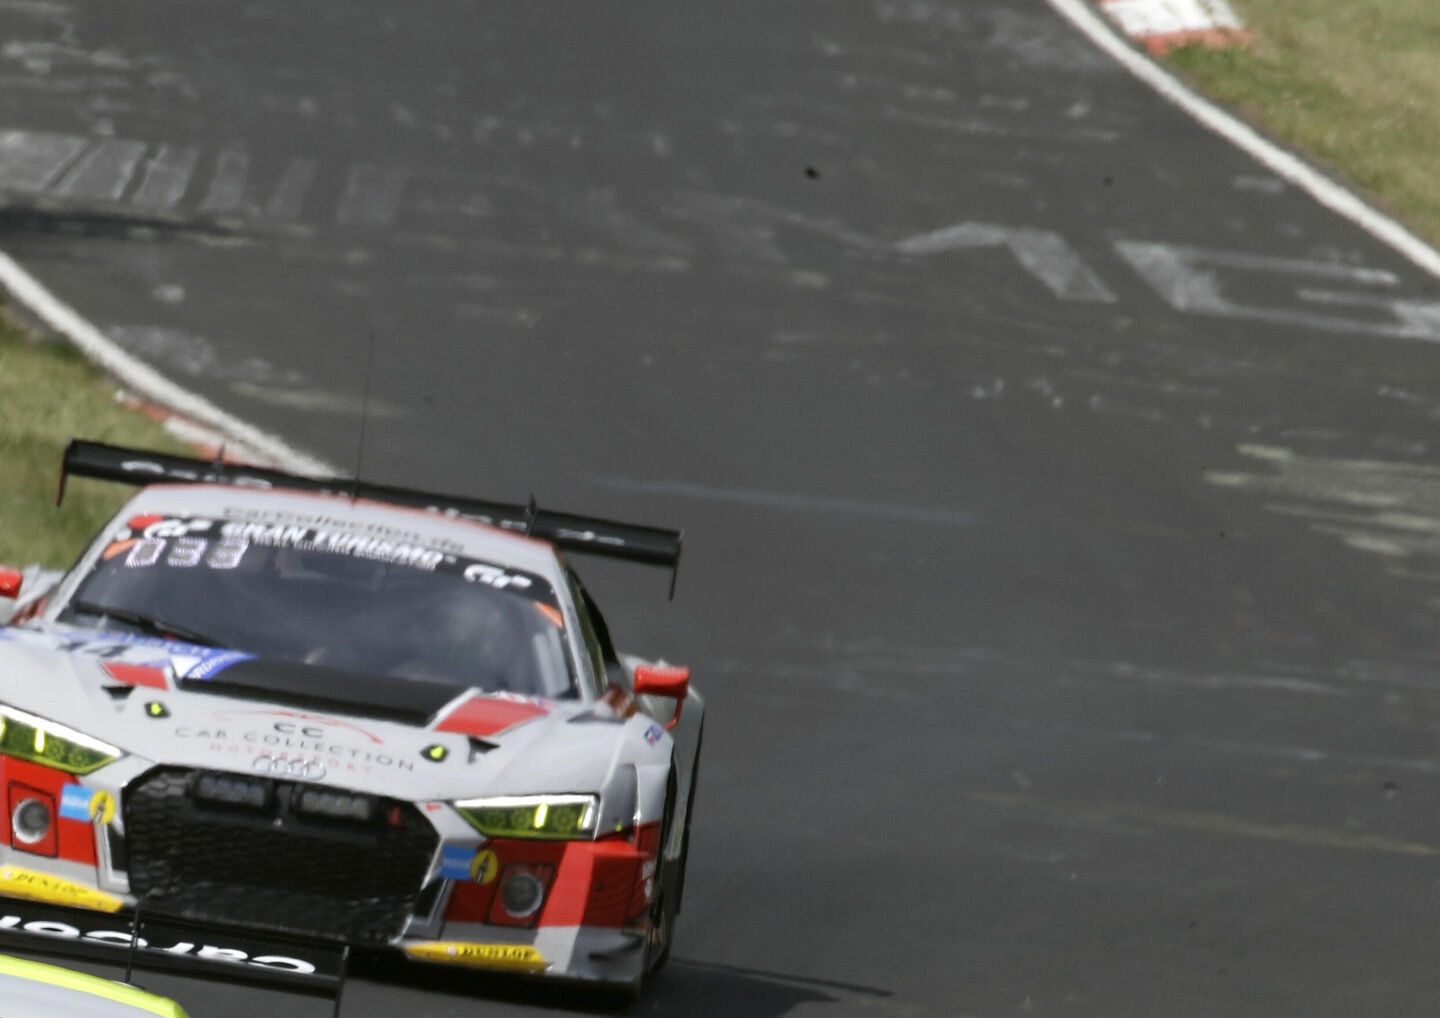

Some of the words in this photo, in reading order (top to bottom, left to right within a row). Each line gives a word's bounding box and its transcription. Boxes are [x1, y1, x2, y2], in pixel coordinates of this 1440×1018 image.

[274, 722, 325, 739] CC
[174, 726, 228, 739] CAR
[244, 733, 415, 771] COLLECTION
